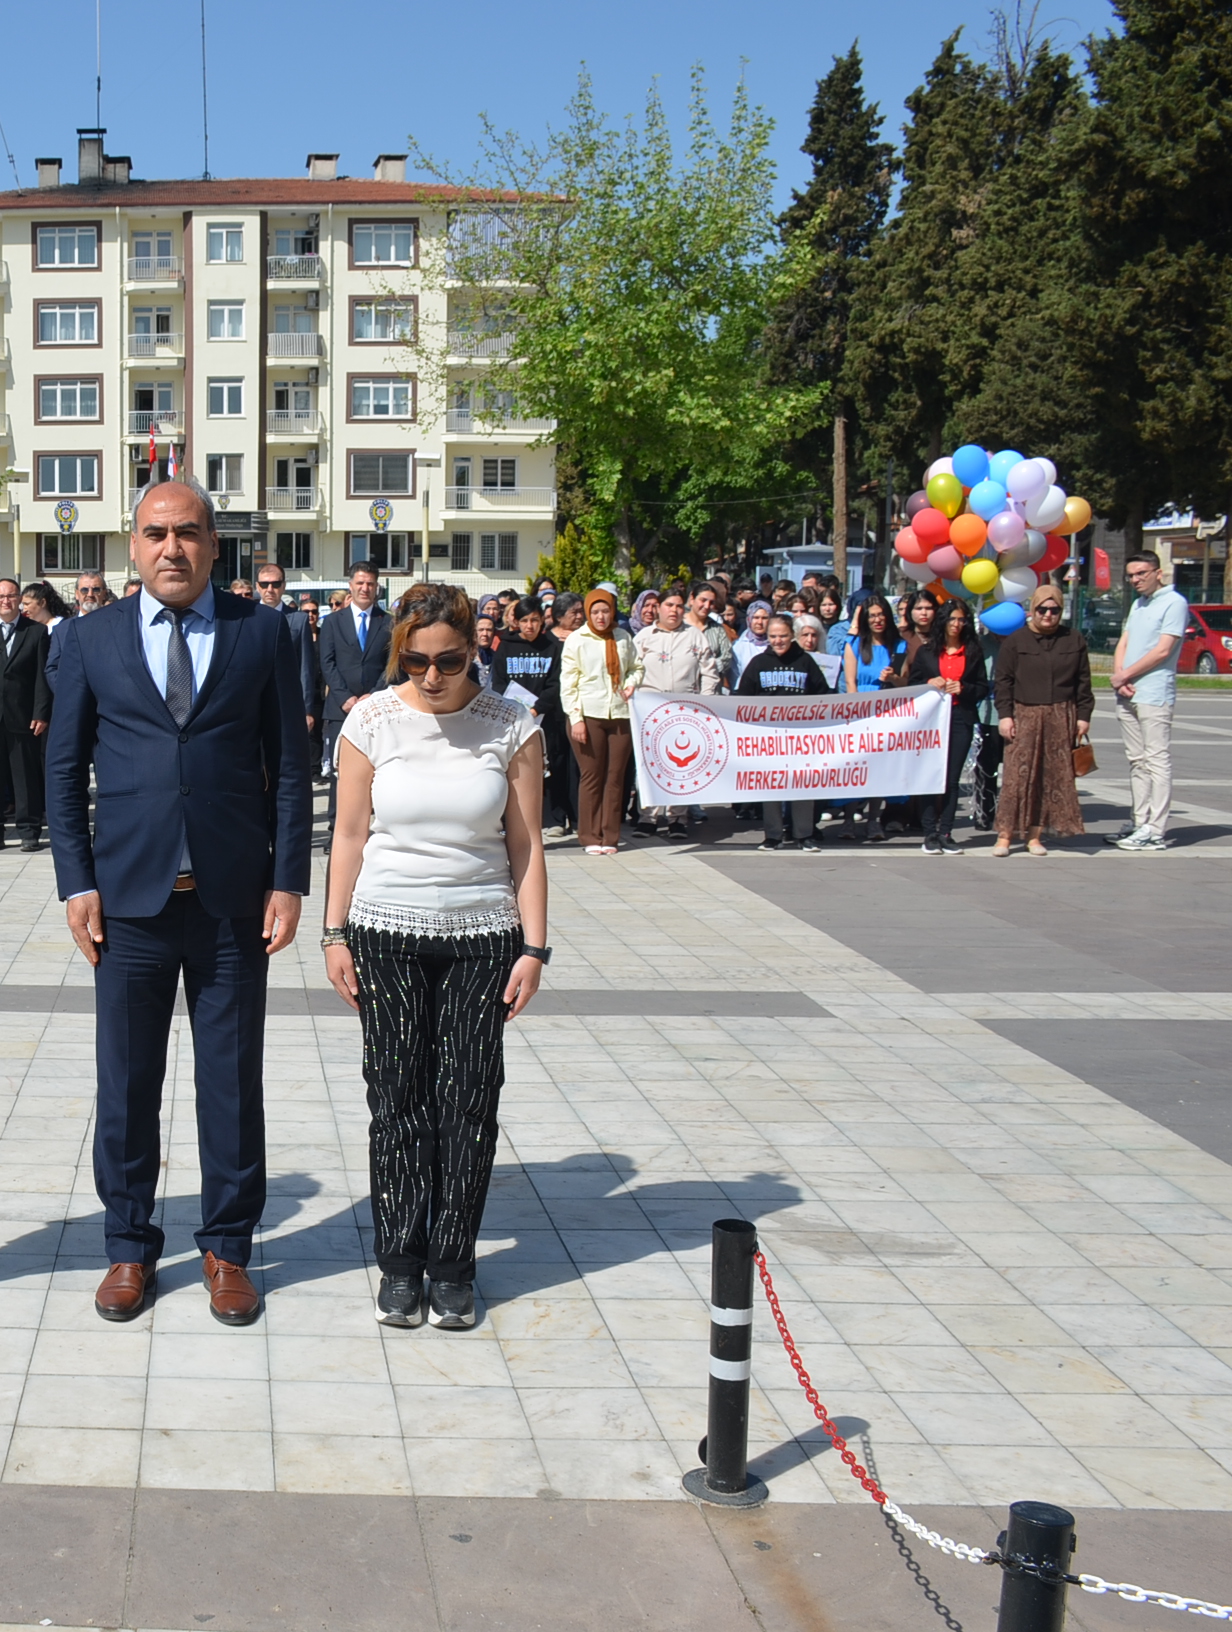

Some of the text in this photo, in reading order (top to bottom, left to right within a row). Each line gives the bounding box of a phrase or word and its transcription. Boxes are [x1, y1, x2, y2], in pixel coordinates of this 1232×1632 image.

[759, 671, 808, 689] BROOKLYN
[736, 697, 919, 726] KULA ENGELSİZ YAŞAM BAKIM,
[736, 726, 940, 757] REHABİLİTASYON VE AİLE DANIŞMA
[736, 760, 868, 790] MERKEZİ MÜDÜRLÜĞÜ
